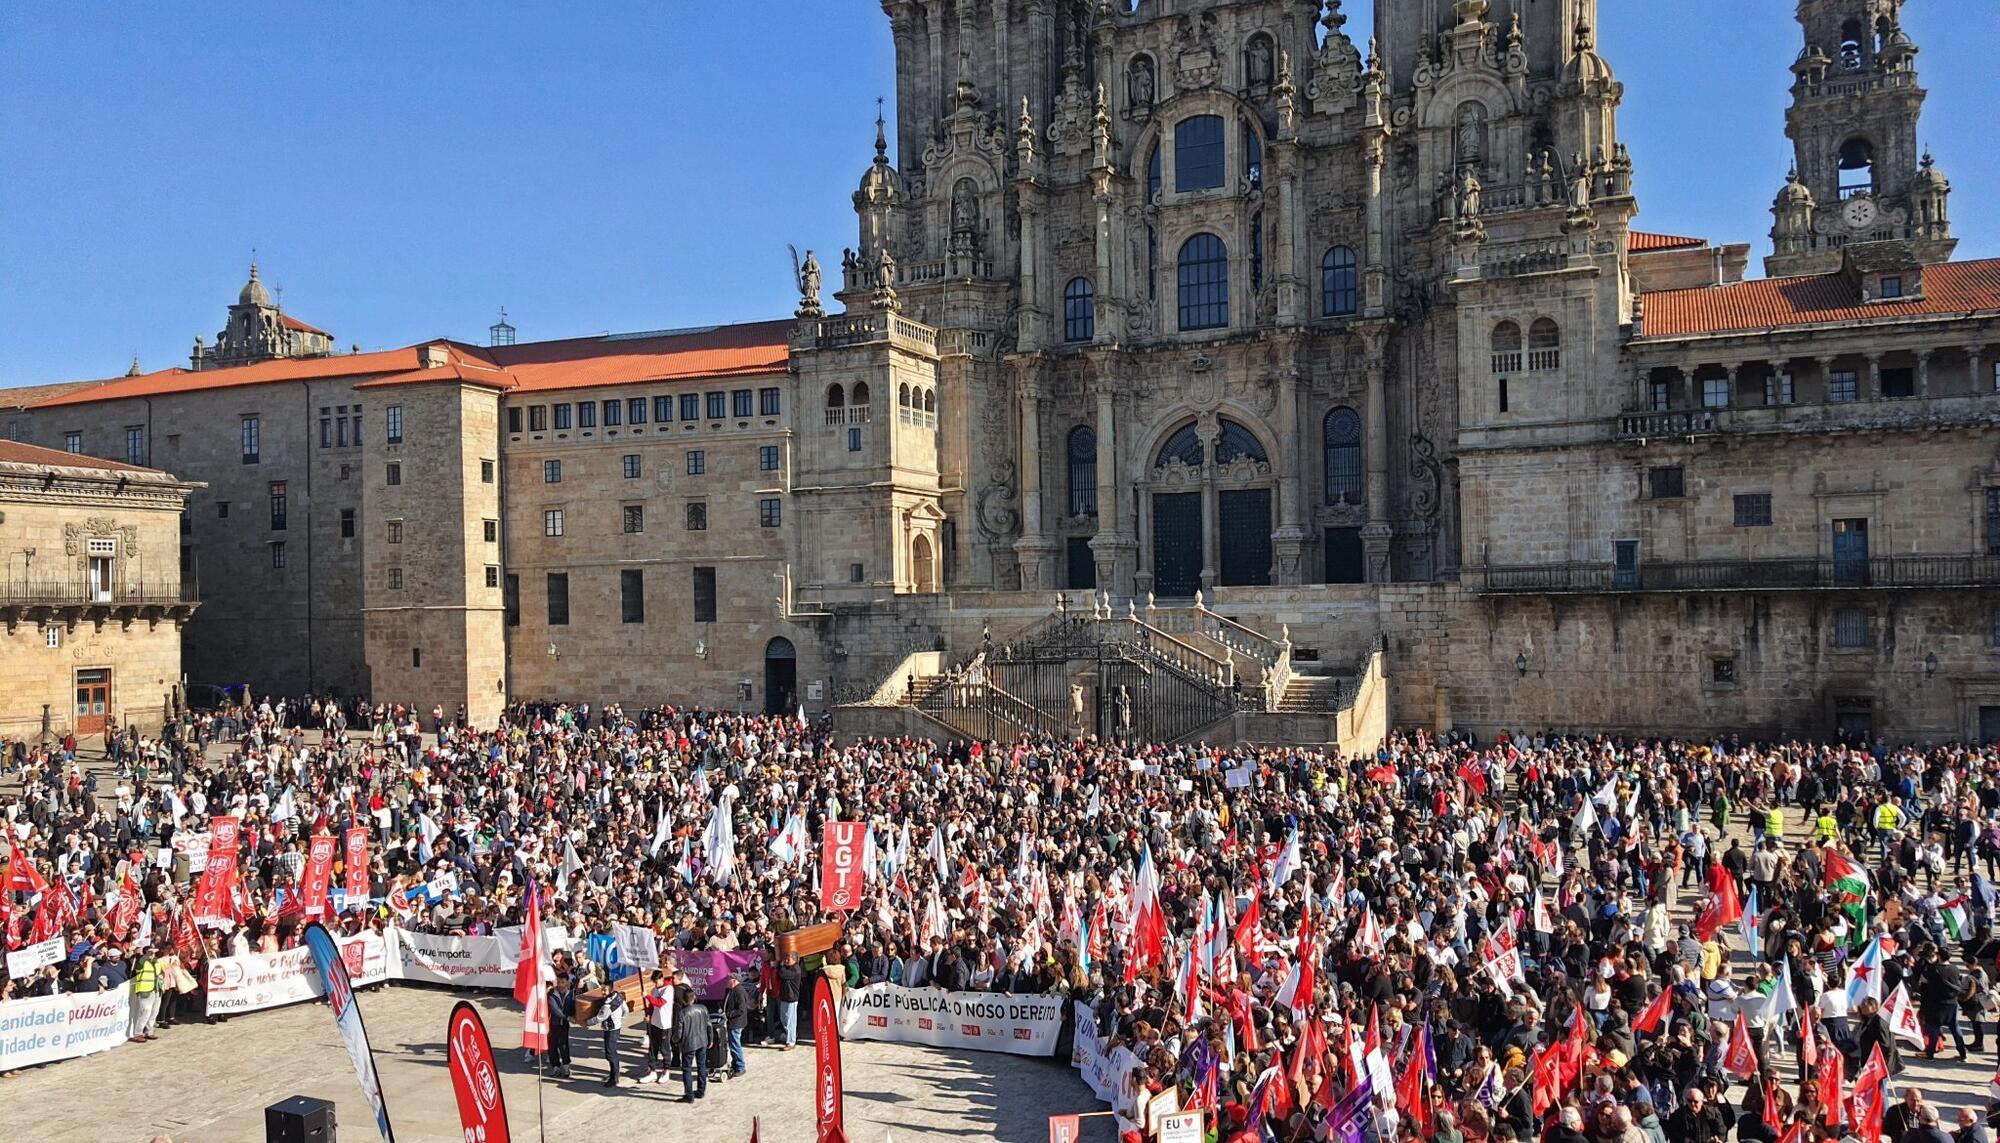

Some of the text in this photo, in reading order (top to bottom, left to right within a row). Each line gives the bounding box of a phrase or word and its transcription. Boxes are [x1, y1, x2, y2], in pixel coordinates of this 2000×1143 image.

[175, 837, 209, 852] SOS
[835, 825, 853, 888] UGT
[311, 864, 324, 907] UGT
[352, 855, 362, 896] UGT
[200, 876, 219, 917] UGT
[418, 948, 436, 957] que
[437, 948, 472, 960] importa:
[450, 964, 477, 976] galega,
[895, 993, 951, 1013] PÚBLICA:
[954, 1002, 962, 1015] O
[966, 1002, 1005, 1020] NOSO
[1010, 1005, 1056, 1021] DEREITO
[51, 1034, 61, 1046] e
[1166, 1119, 1180, 1130] EU
